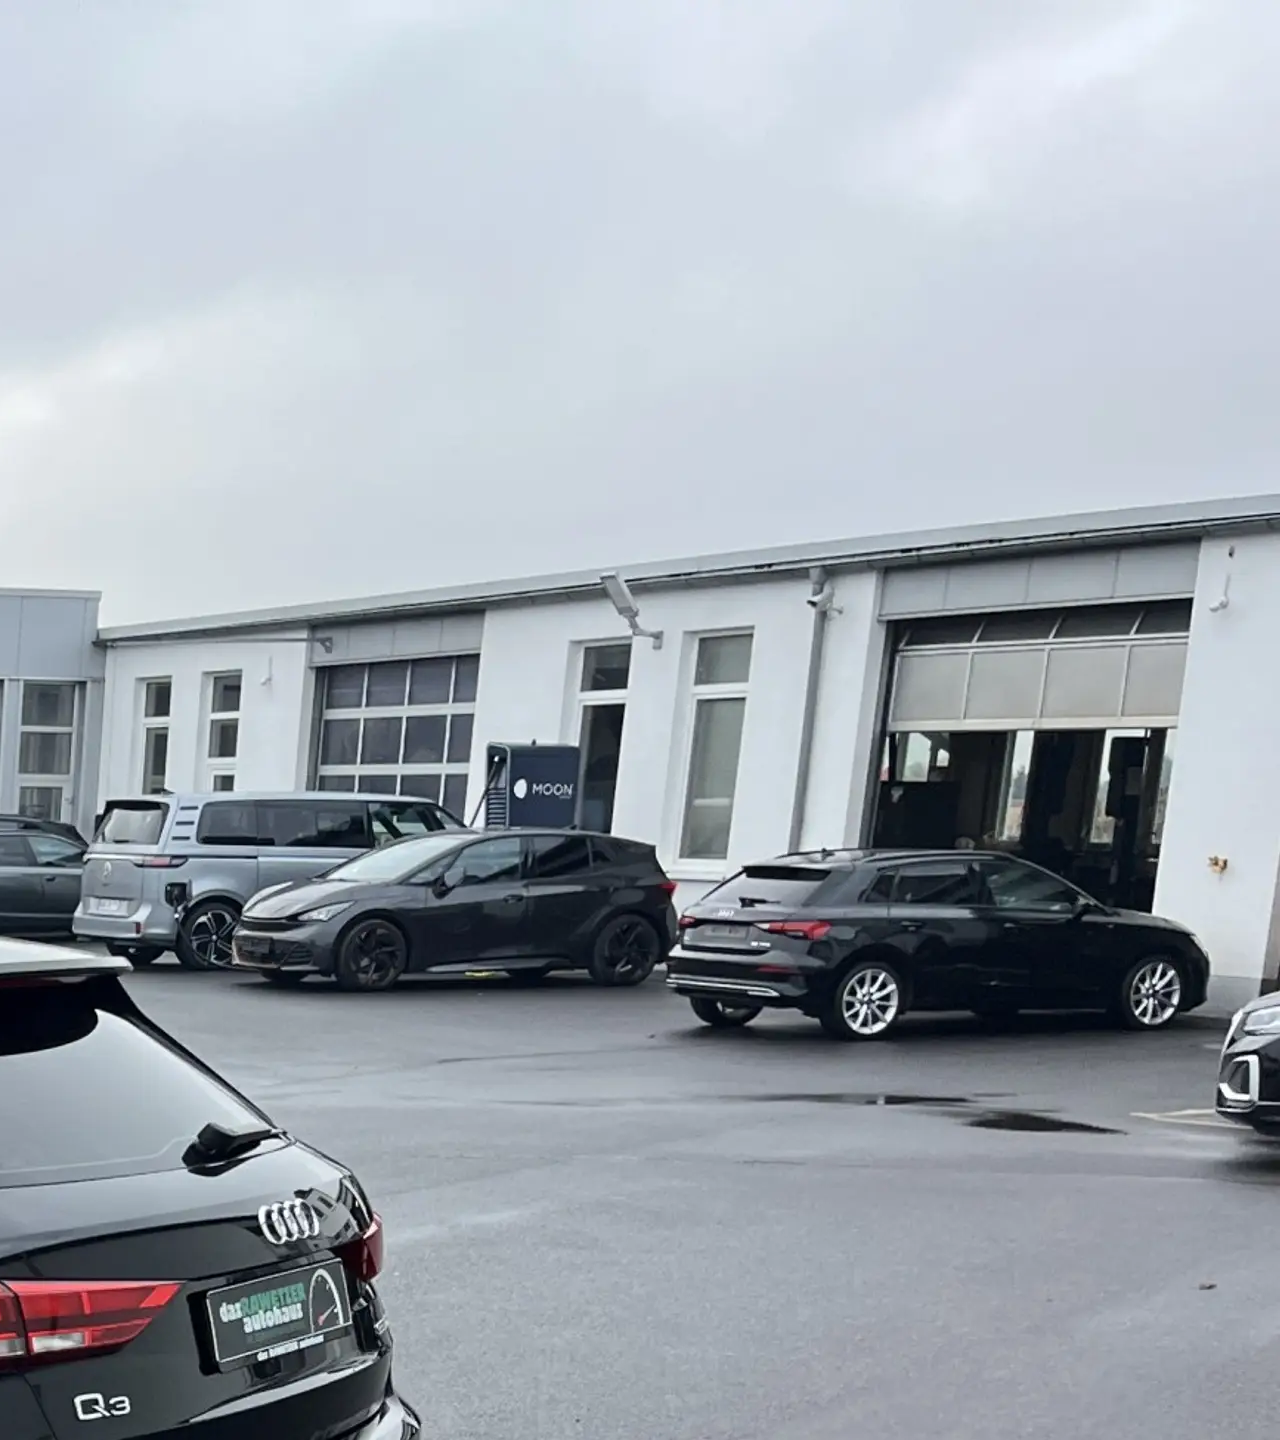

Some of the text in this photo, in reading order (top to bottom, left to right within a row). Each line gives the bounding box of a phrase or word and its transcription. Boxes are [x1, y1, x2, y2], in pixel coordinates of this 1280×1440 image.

[532, 782, 574, 796] MOON
[242, 1302, 304, 1333] autohaus
[73, 1392, 131, 1421] Q3
